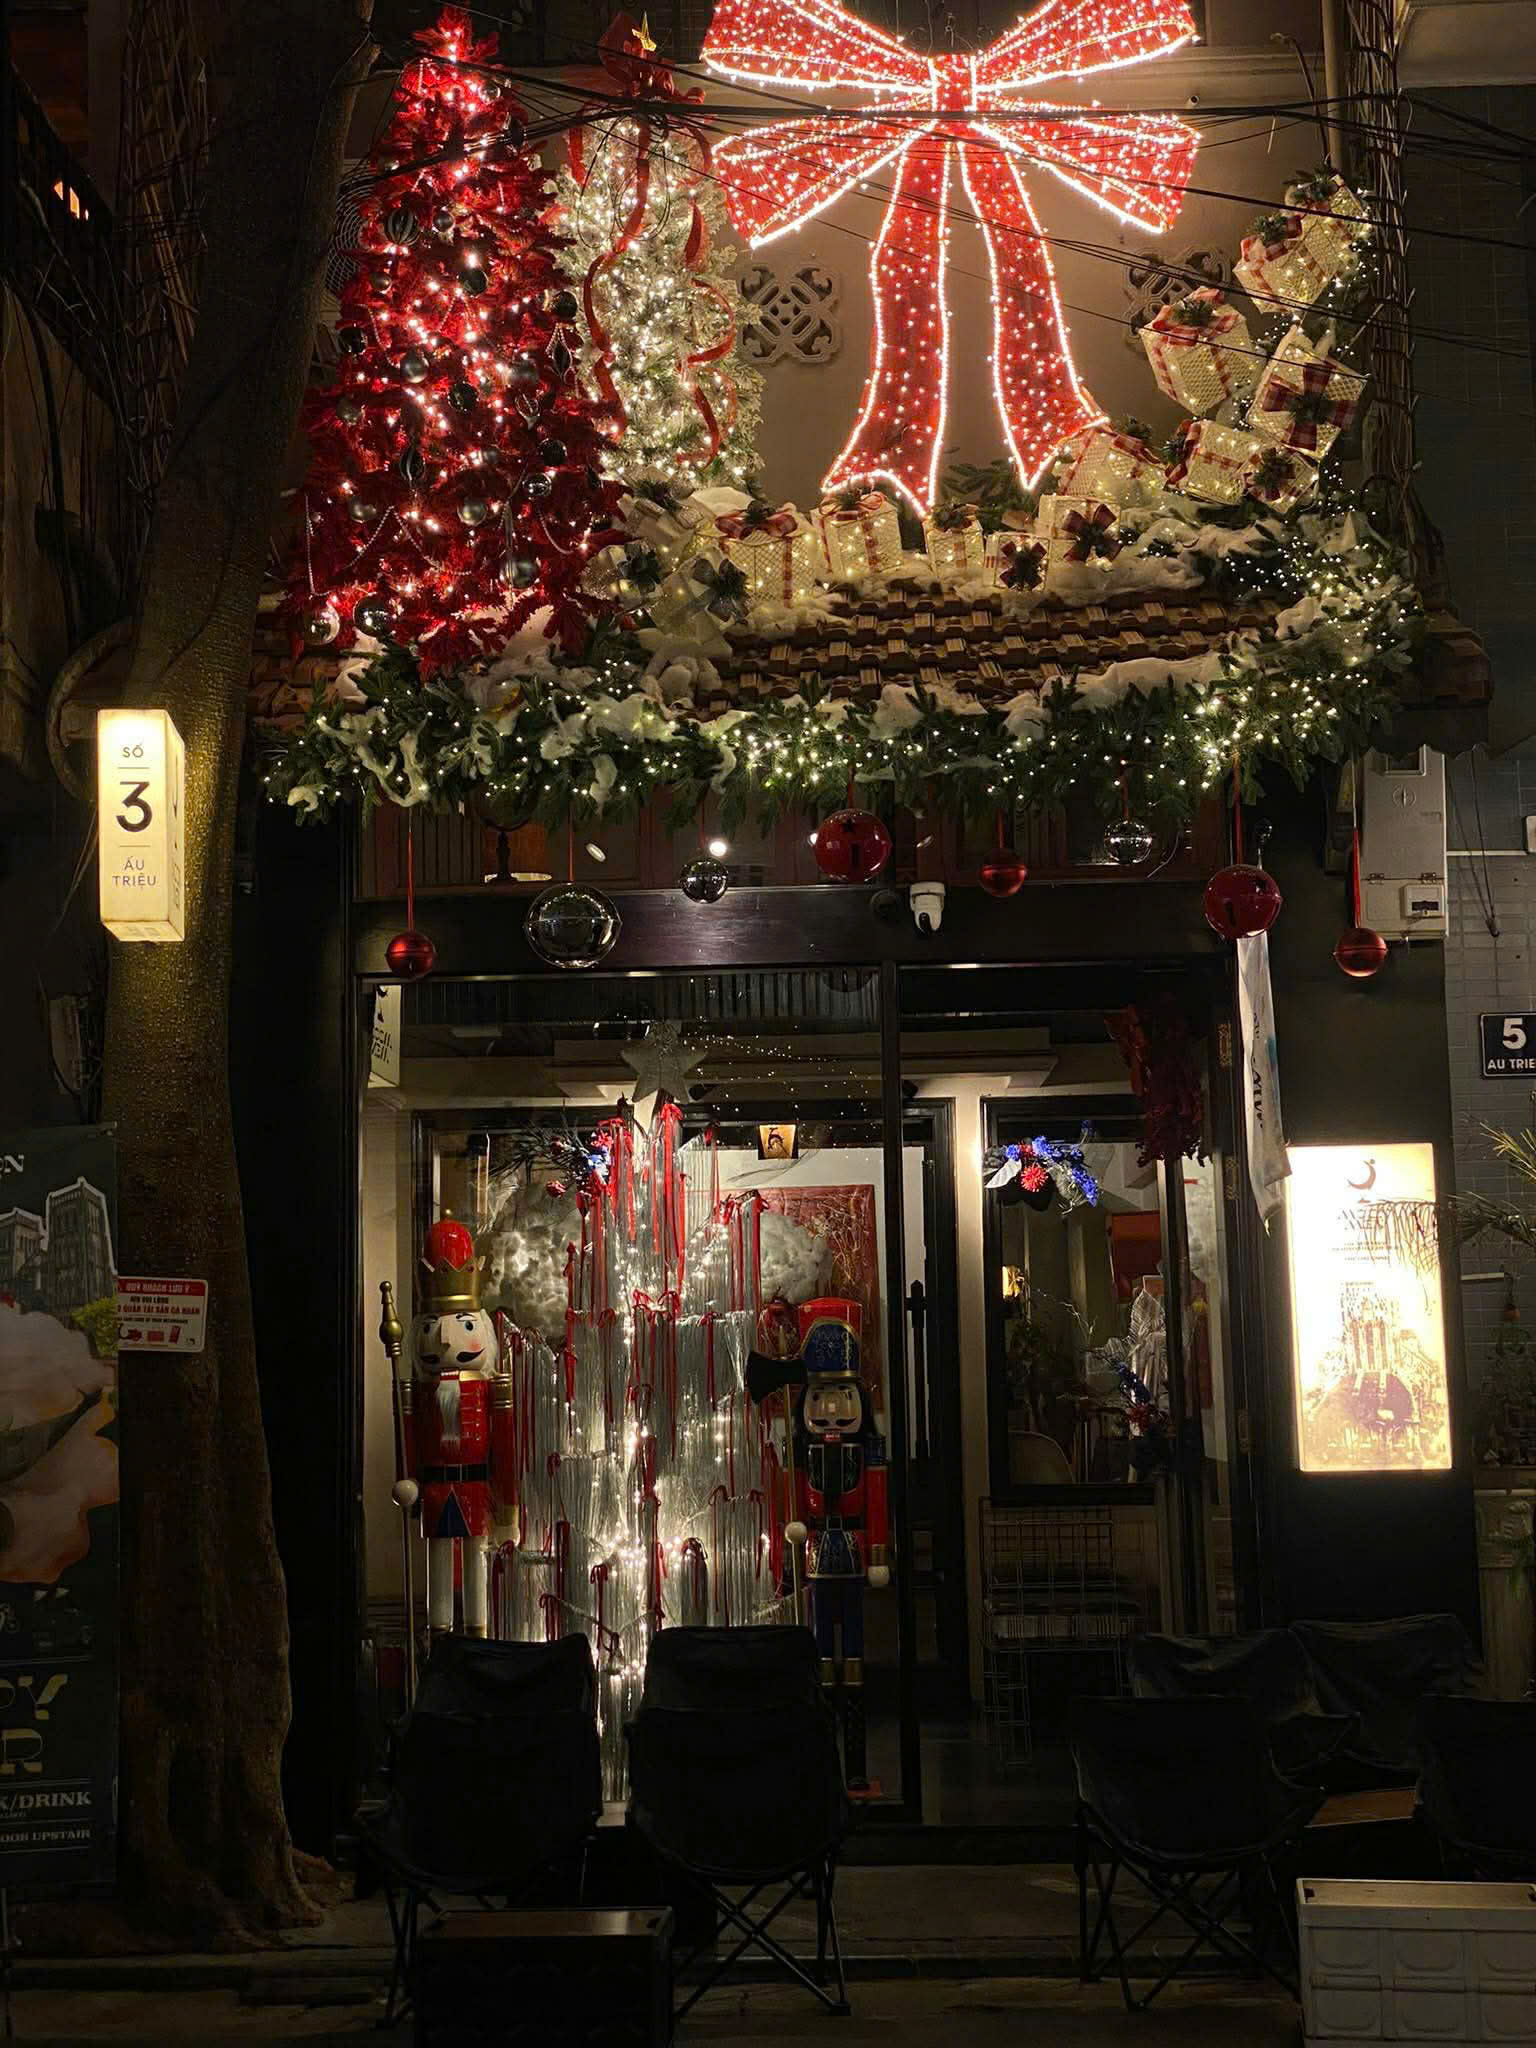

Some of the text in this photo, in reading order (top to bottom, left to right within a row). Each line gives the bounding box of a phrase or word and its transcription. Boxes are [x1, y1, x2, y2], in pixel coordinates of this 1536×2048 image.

[122, 742, 144, 758] SỐ
[116, 781, 153, 832] 3
[112, 872, 156, 889] TRIỆU
[1502, 1017, 1528, 1050] 5
[1487, 1058, 1505, 1070] AU
